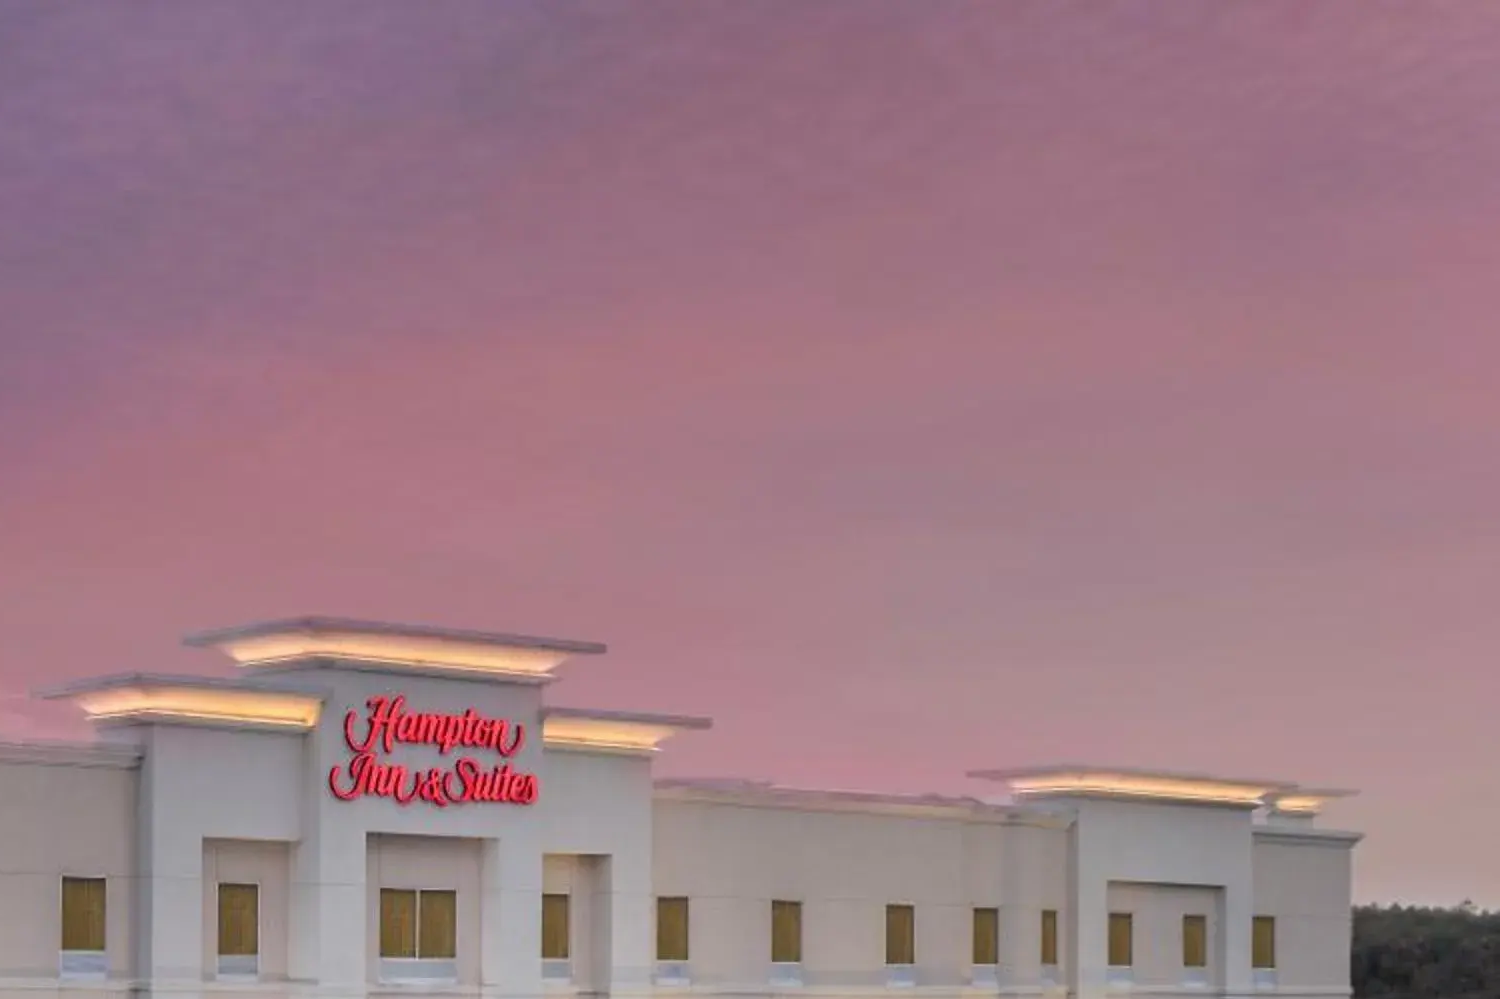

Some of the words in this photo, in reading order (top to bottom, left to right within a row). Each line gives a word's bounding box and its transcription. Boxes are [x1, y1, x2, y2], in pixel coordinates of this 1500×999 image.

[344, 695, 524, 756] Hampton
[329, 753, 421, 804] Inn
[419, 767, 447, 806] &
[443, 757, 537, 805] Suites
